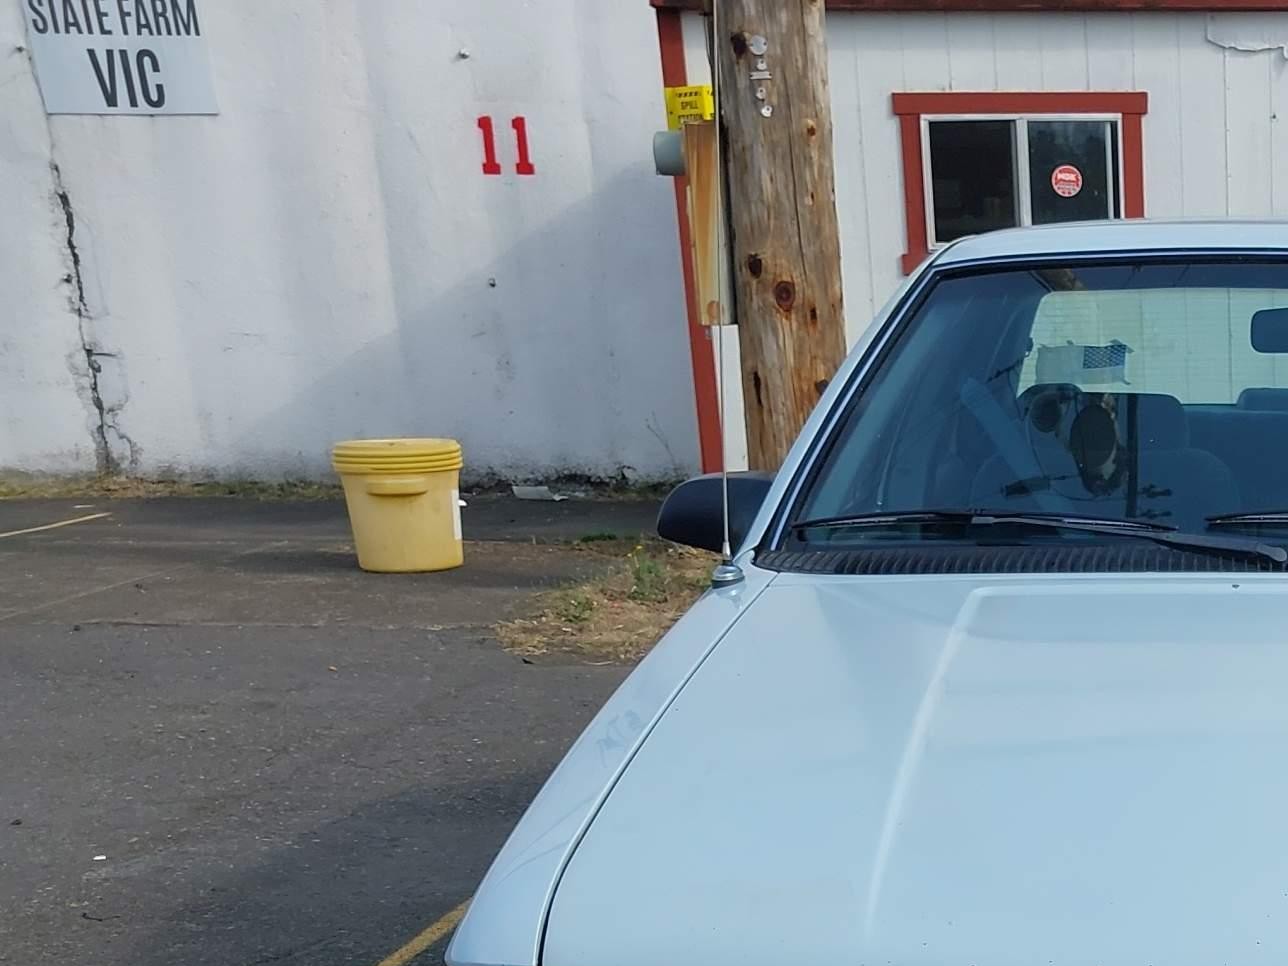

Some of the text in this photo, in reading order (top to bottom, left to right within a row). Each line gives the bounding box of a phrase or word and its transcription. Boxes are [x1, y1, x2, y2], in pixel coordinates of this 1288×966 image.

[28, 0, 201, 36] STATE FARM
[86, 48, 166, 108] VIC
[478, 115, 536, 175] 11
